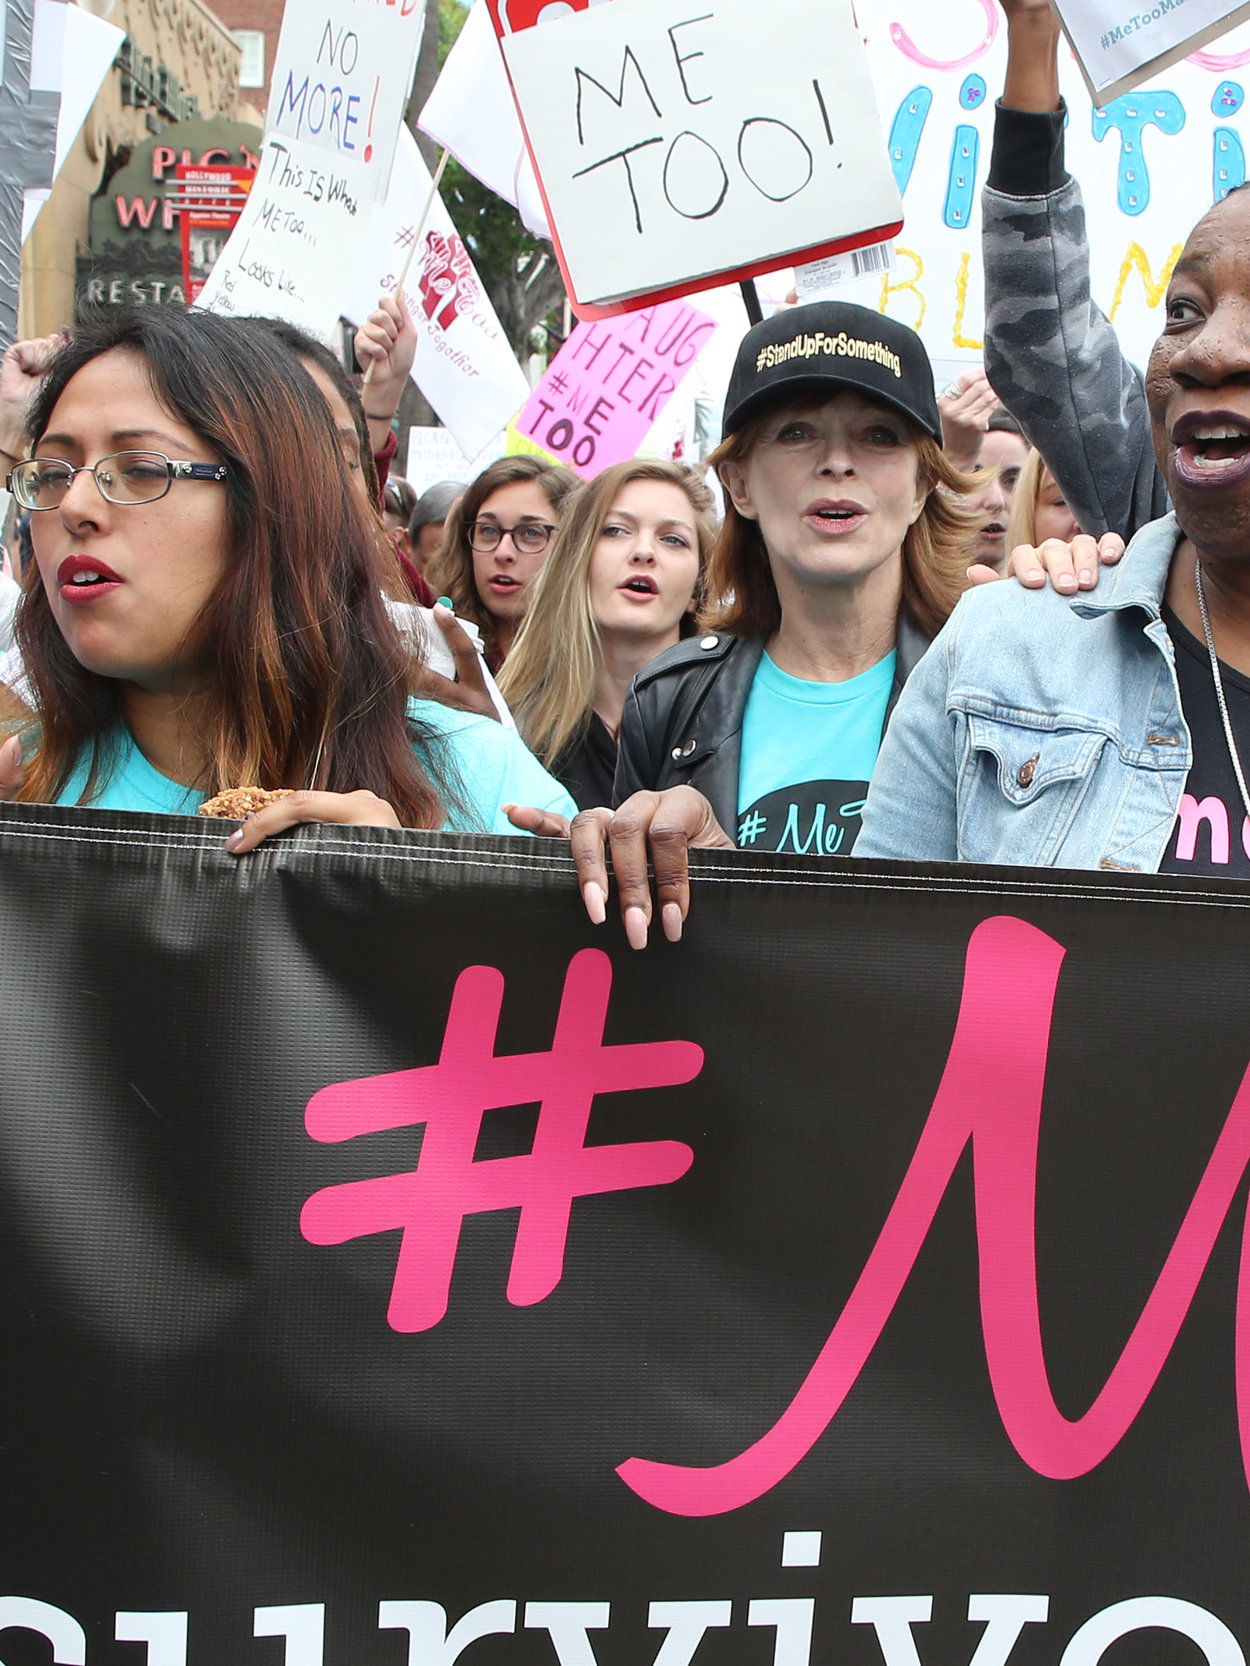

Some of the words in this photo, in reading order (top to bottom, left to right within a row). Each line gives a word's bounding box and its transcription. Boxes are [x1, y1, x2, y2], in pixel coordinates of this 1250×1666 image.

[316, 18, 359, 76] NO
[574, 14, 714, 146] ME
[276, 69, 380, 163] MORE!
[269, 140, 304, 188] This
[327, 173, 358, 217] What
[572, 79, 844, 236] TOO!
[380, 273, 429, 324] Stnger
[571, 323, 676, 423] HTER
[756, 331, 902, 378] #StandUpForSomething
[528, 398, 597, 468] TOO
[549, 370, 616, 436] #ME
